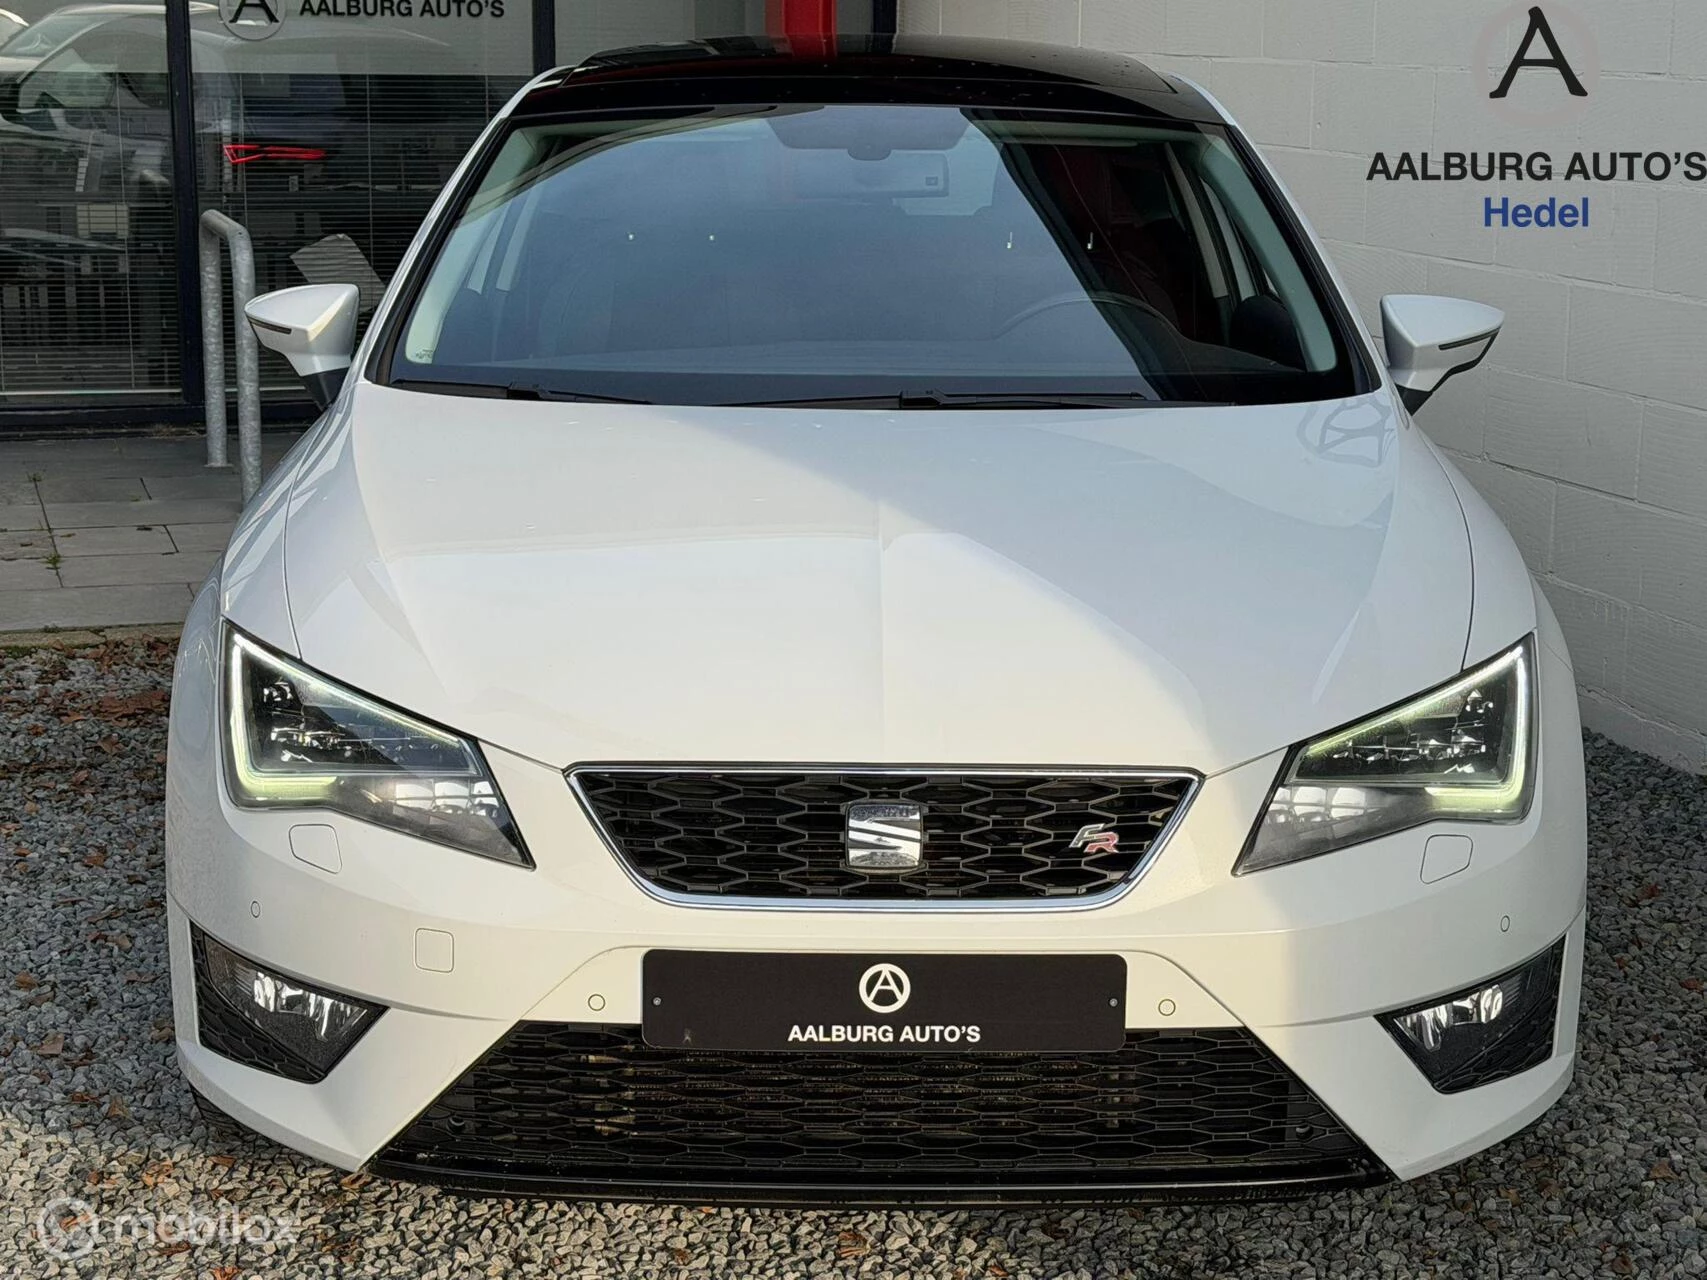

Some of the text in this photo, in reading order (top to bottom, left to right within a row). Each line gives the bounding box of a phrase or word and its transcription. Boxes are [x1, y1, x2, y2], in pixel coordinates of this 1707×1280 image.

[299, 0, 505, 18] AALBURG AUTO'S
[1067, 823, 1121, 854] FR
[787, 1025, 982, 1044] AALBURG AUTO'S
